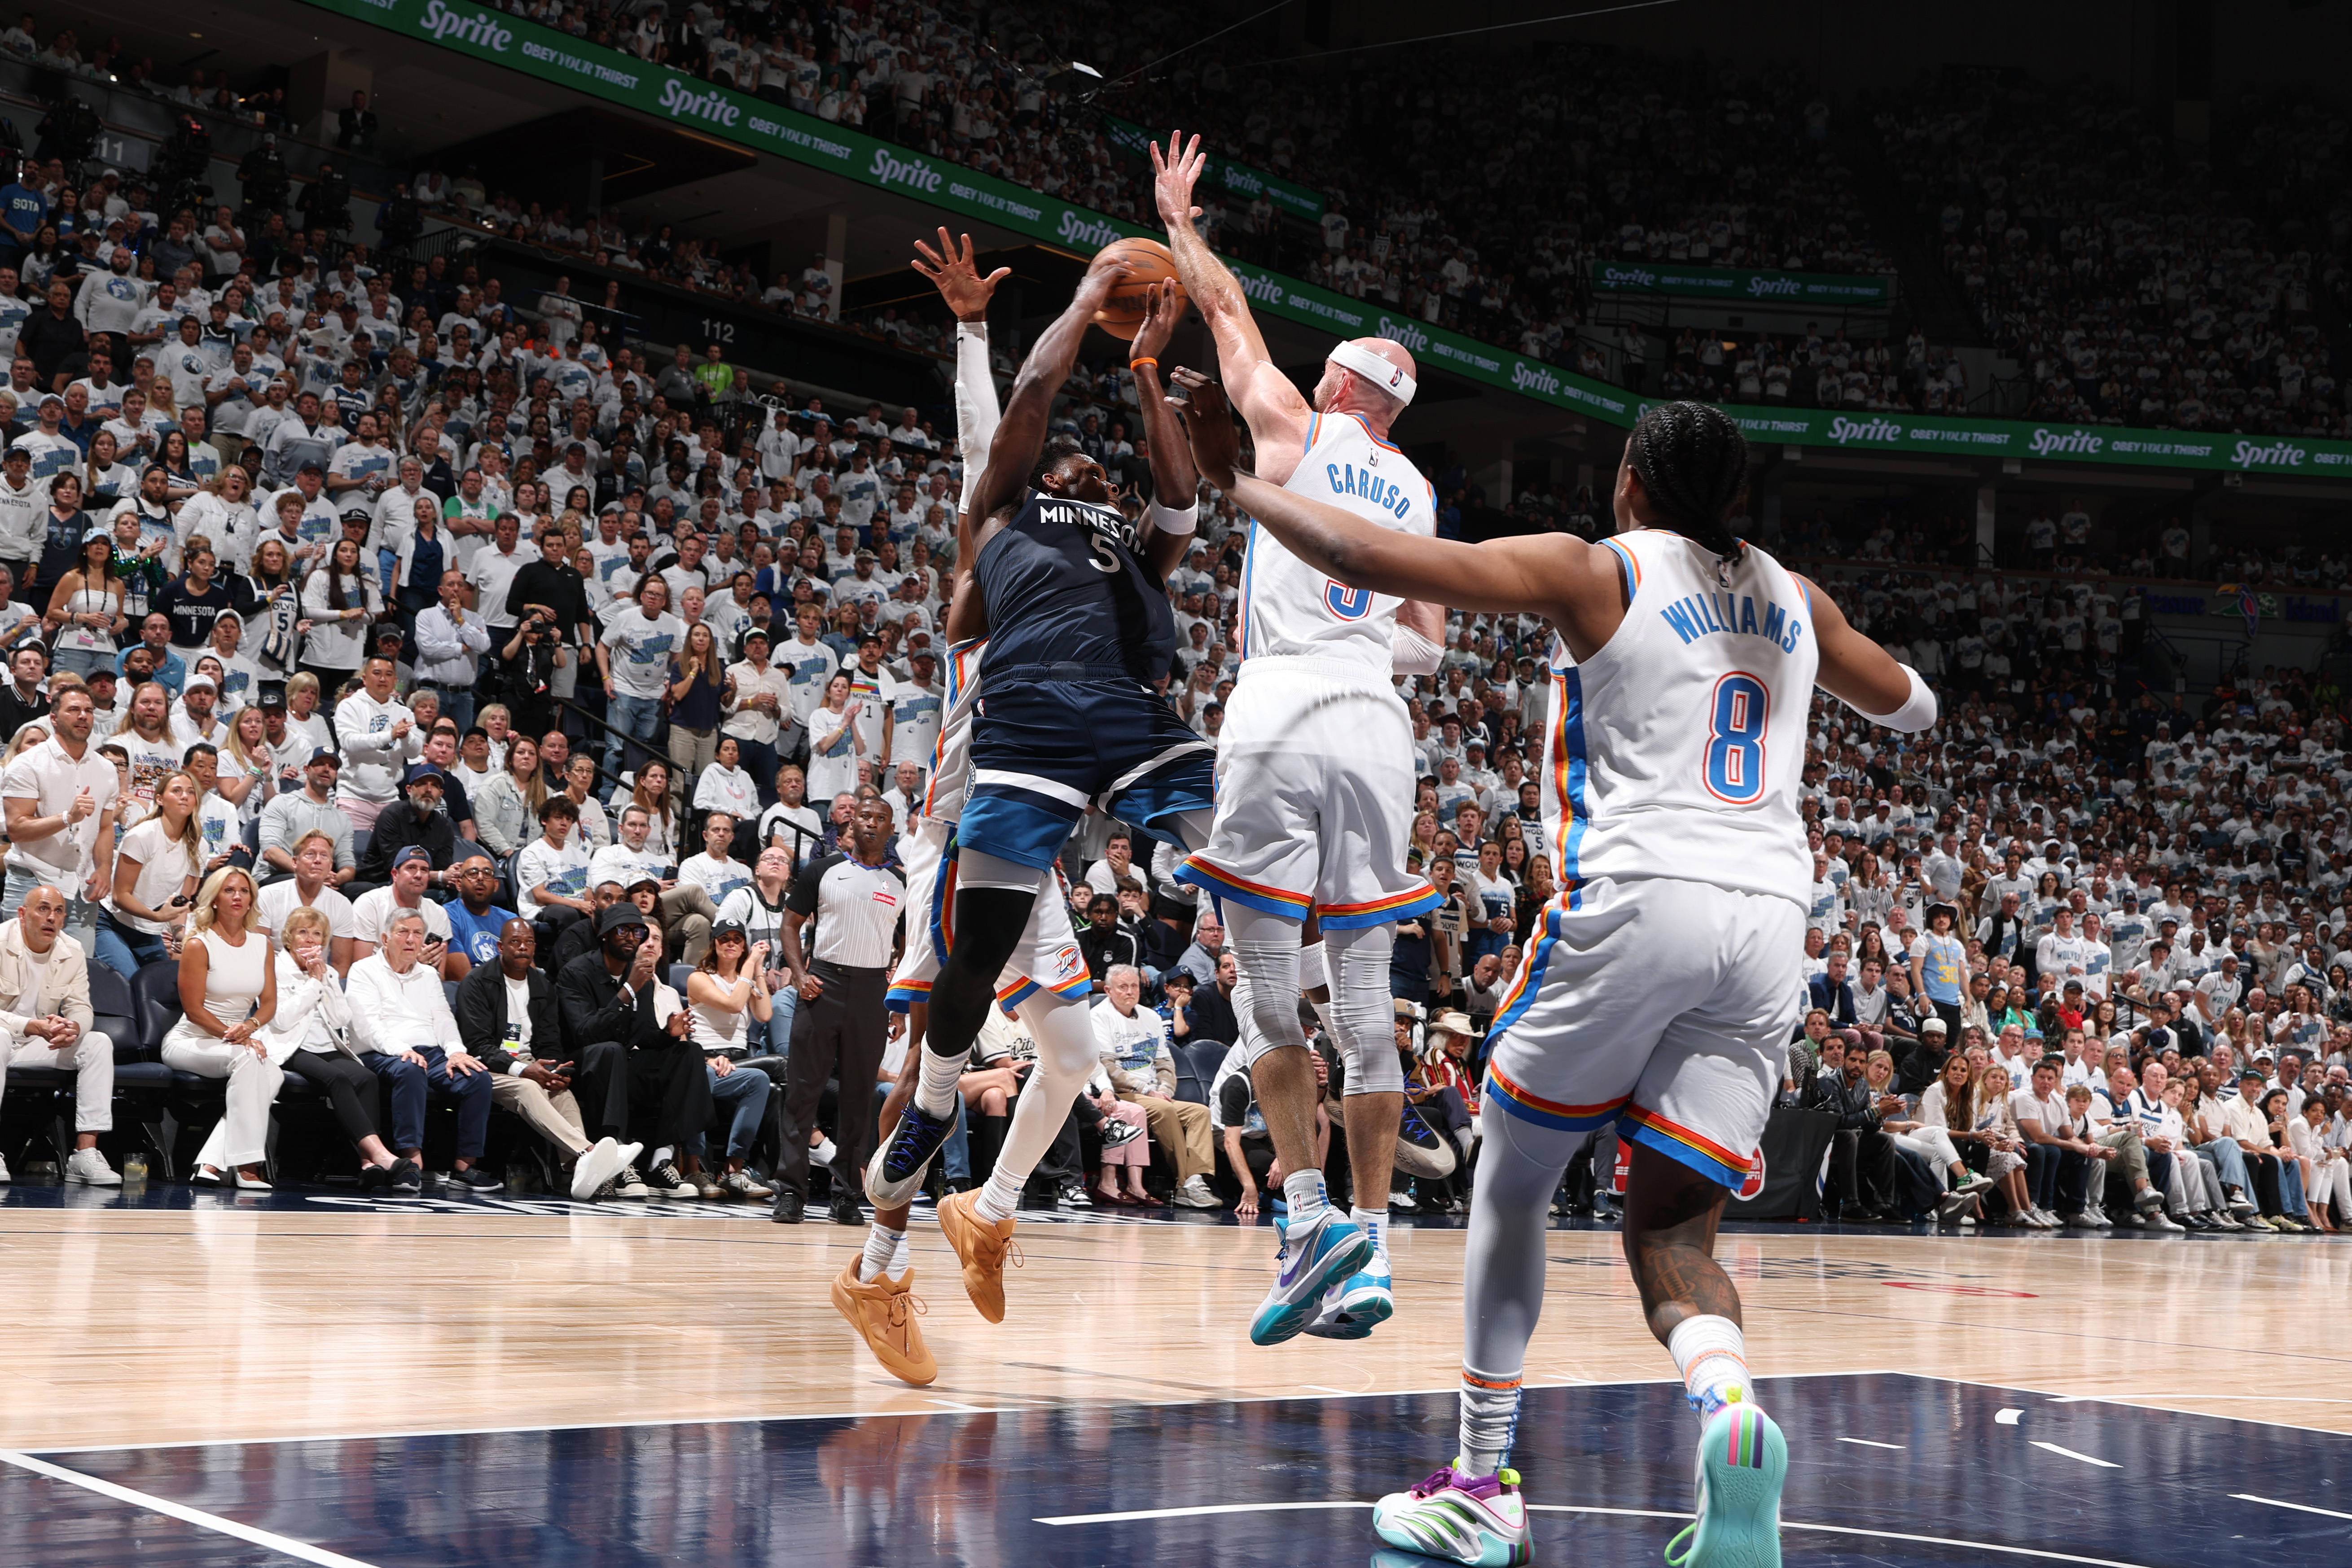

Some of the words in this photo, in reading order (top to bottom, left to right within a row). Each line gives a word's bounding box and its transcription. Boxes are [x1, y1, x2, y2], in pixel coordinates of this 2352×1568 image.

[420, 0, 513, 52] Sprite
[522, 42, 557, 63] OBEY
[594, 64, 639, 89] THIRST
[658, 79, 740, 127] Sprite
[748, 117, 780, 136] OBEY
[812, 136, 852, 159] THIRST
[869, 149, 942, 193] Sprite
[1224, 166, 1264, 195] Sprite
[949, 183, 977, 201] OBEY
[1006, 200, 1043, 221] THIRST
[1058, 210, 1122, 245] Sprite
[1601, 268, 1655, 287] Sprite
[1747, 276, 1801, 296] Sprite
[702, 318, 734, 344] 112
[1375, 316, 1428, 352] Sprite
[1511, 361, 1560, 395] Sprite
[1771, 420, 1809, 433] THIRST
[1827, 416, 1901, 443] Sprite
[1910, 429, 1940, 440] OBEY
[1971, 432, 2010, 444] THIRST
[2028, 428, 2103, 455] Sprite
[2112, 441, 2140, 452] OBEY
[2173, 445, 2212, 456] THIRST
[2231, 440, 2306, 468] Sprite
[2313, 452, 2342, 464] OBEY
[1326, 463, 1410, 519] CARUSO
[1088, 533, 1121, 573] 5
[174, 605, 216, 617] MINNESOTA
[272, 603, 300, 612] OLVE
[2286, 596, 2339, 622] Island
[191, 616, 197, 635] 1
[276, 613, 286, 631] 5
[1660, 593, 1802, 653] WILLIAMS
[853, 692, 882, 702] MINNESO
[865, 705, 872, 718] 1
[1703, 670, 1769, 804] 8
[1536, 837, 1543, 850] 5
[873, 894, 896, 904] Emirates
[1500, 902, 1508, 917] 5
[1906, 897, 1914, 909] 5
[1060, 950, 1077, 972] OKC
[2216, 1006, 2223, 1016] 5
